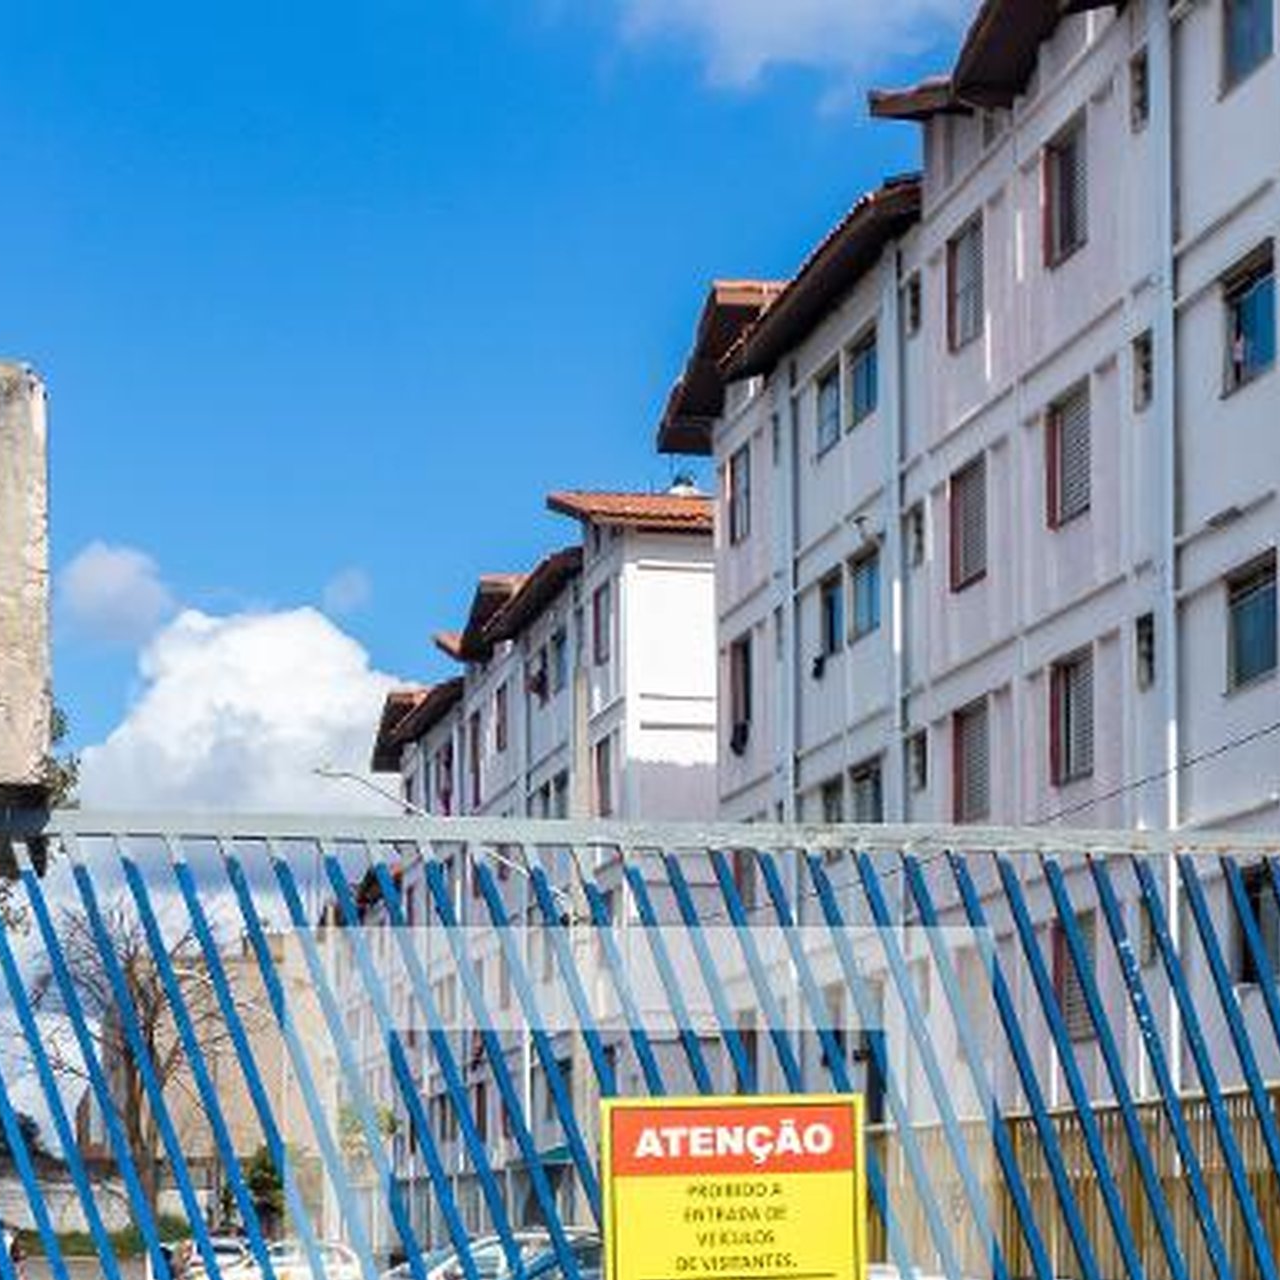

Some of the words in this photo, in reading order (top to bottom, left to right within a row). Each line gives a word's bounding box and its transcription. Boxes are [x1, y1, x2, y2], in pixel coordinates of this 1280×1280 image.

[634, 1118, 834, 1164] ATENÇÃO
[687, 1182, 768, 1198] PROIBIDO
[769, 1182, 782, 1197] A
[684, 1206, 761, 1222] ENTRADA
[764, 1205, 787, 1221] DE
[675, 1256, 698, 1271] DE
